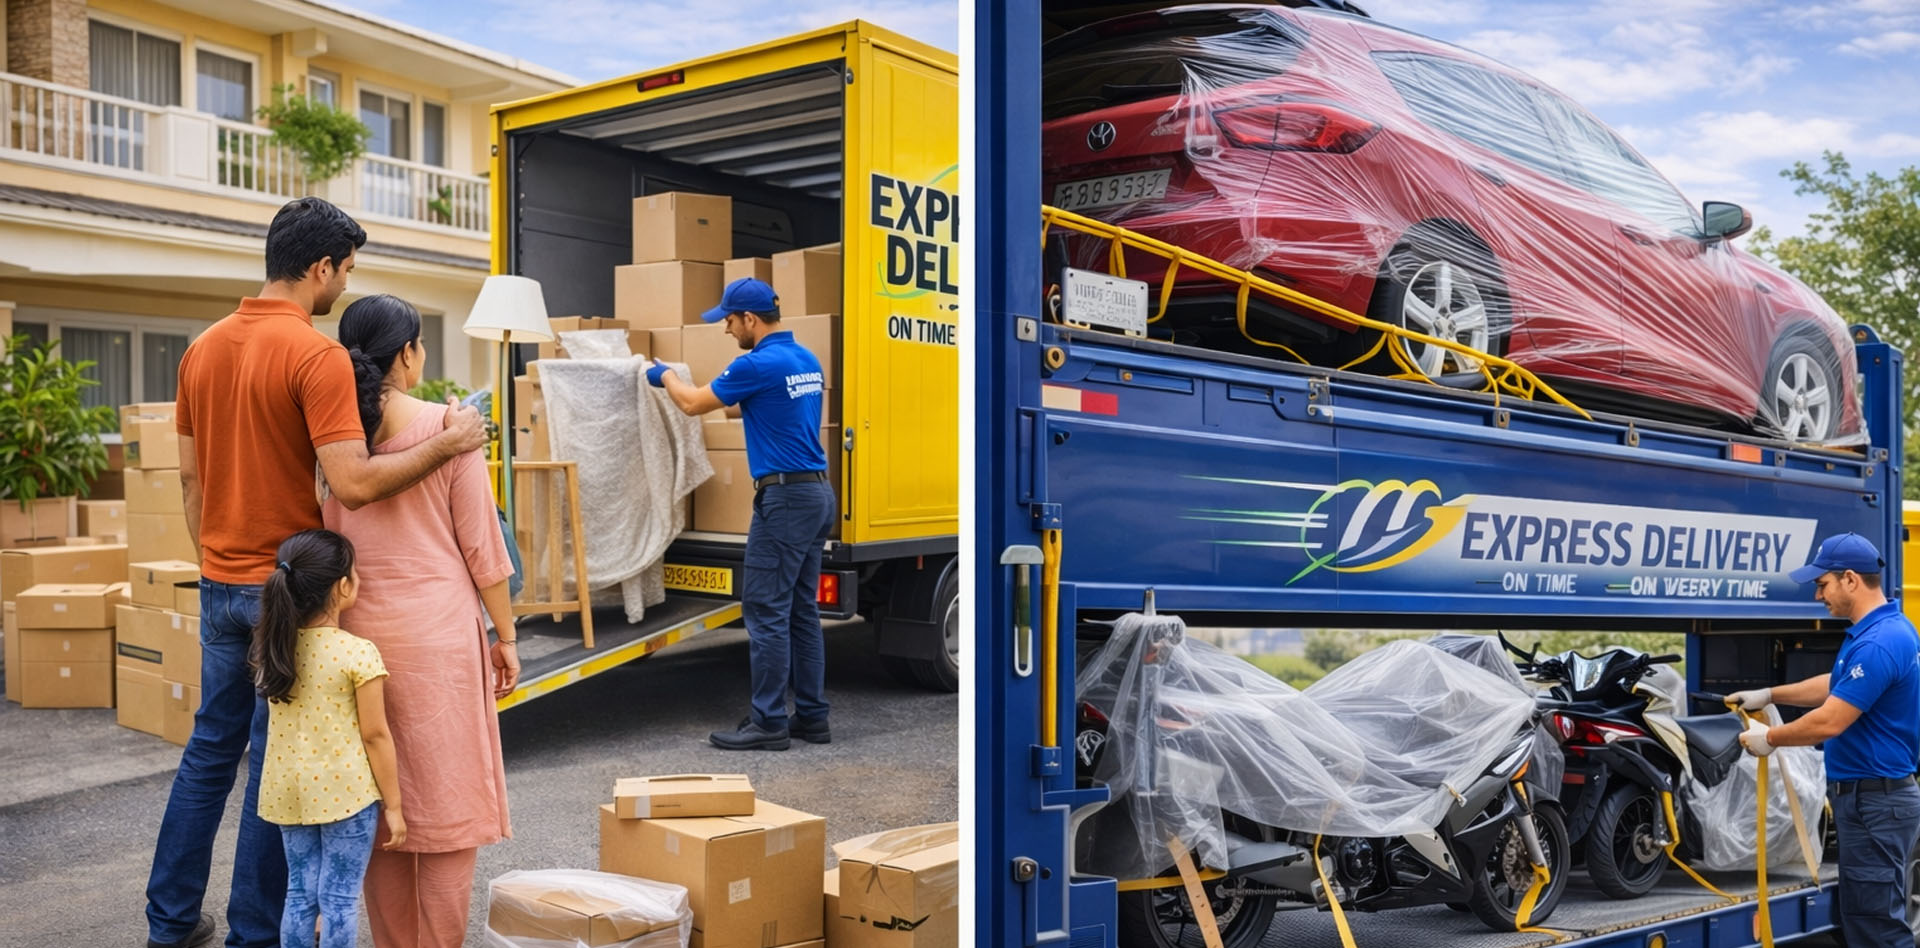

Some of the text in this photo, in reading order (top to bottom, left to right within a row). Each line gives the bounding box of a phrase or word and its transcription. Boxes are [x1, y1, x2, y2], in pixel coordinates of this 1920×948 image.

[888, 316, 956, 345] ON TIME
[1460, 512, 1791, 573] EXPRESS DELIVERY
[1503, 572, 1578, 594] ON TIME
[1630, 576, 1658, 596] ON
[1727, 579, 1769, 600] TIME
